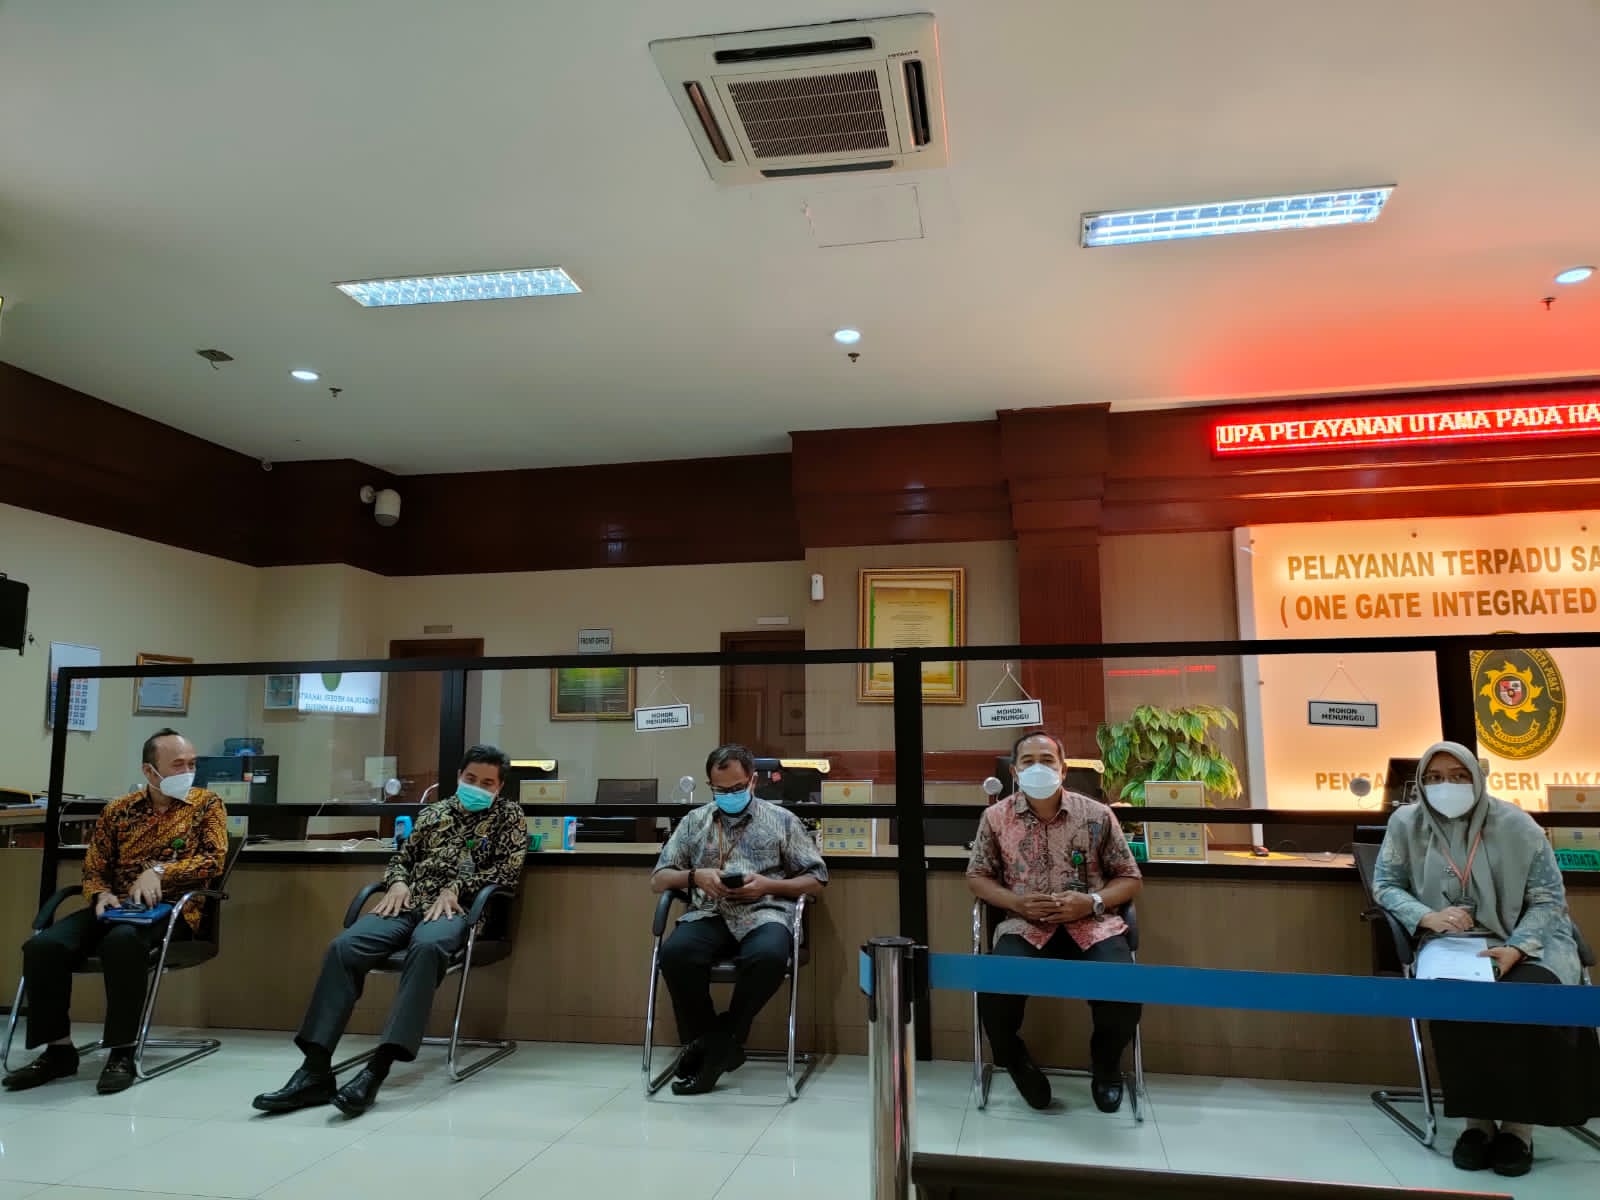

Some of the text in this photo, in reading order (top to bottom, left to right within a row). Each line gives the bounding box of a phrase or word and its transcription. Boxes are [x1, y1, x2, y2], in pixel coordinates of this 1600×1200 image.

[1270, 416, 1403, 441] PELAYANAN
[1409, 411, 1491, 433] UTAMA
[1496, 406, 1563, 428] PADA
[1288, 551, 1435, 580] PELAYANAN
[1442, 547, 1561, 576] TERPADU
[1295, 594, 1347, 621] ONE
[1355, 592, 1422, 619] GATE
[1432, 587, 1597, 617] INTEGRATED
[991, 713, 1030, 721] MENUNGGU
[1321, 713, 1365, 721] MENUNGGU
